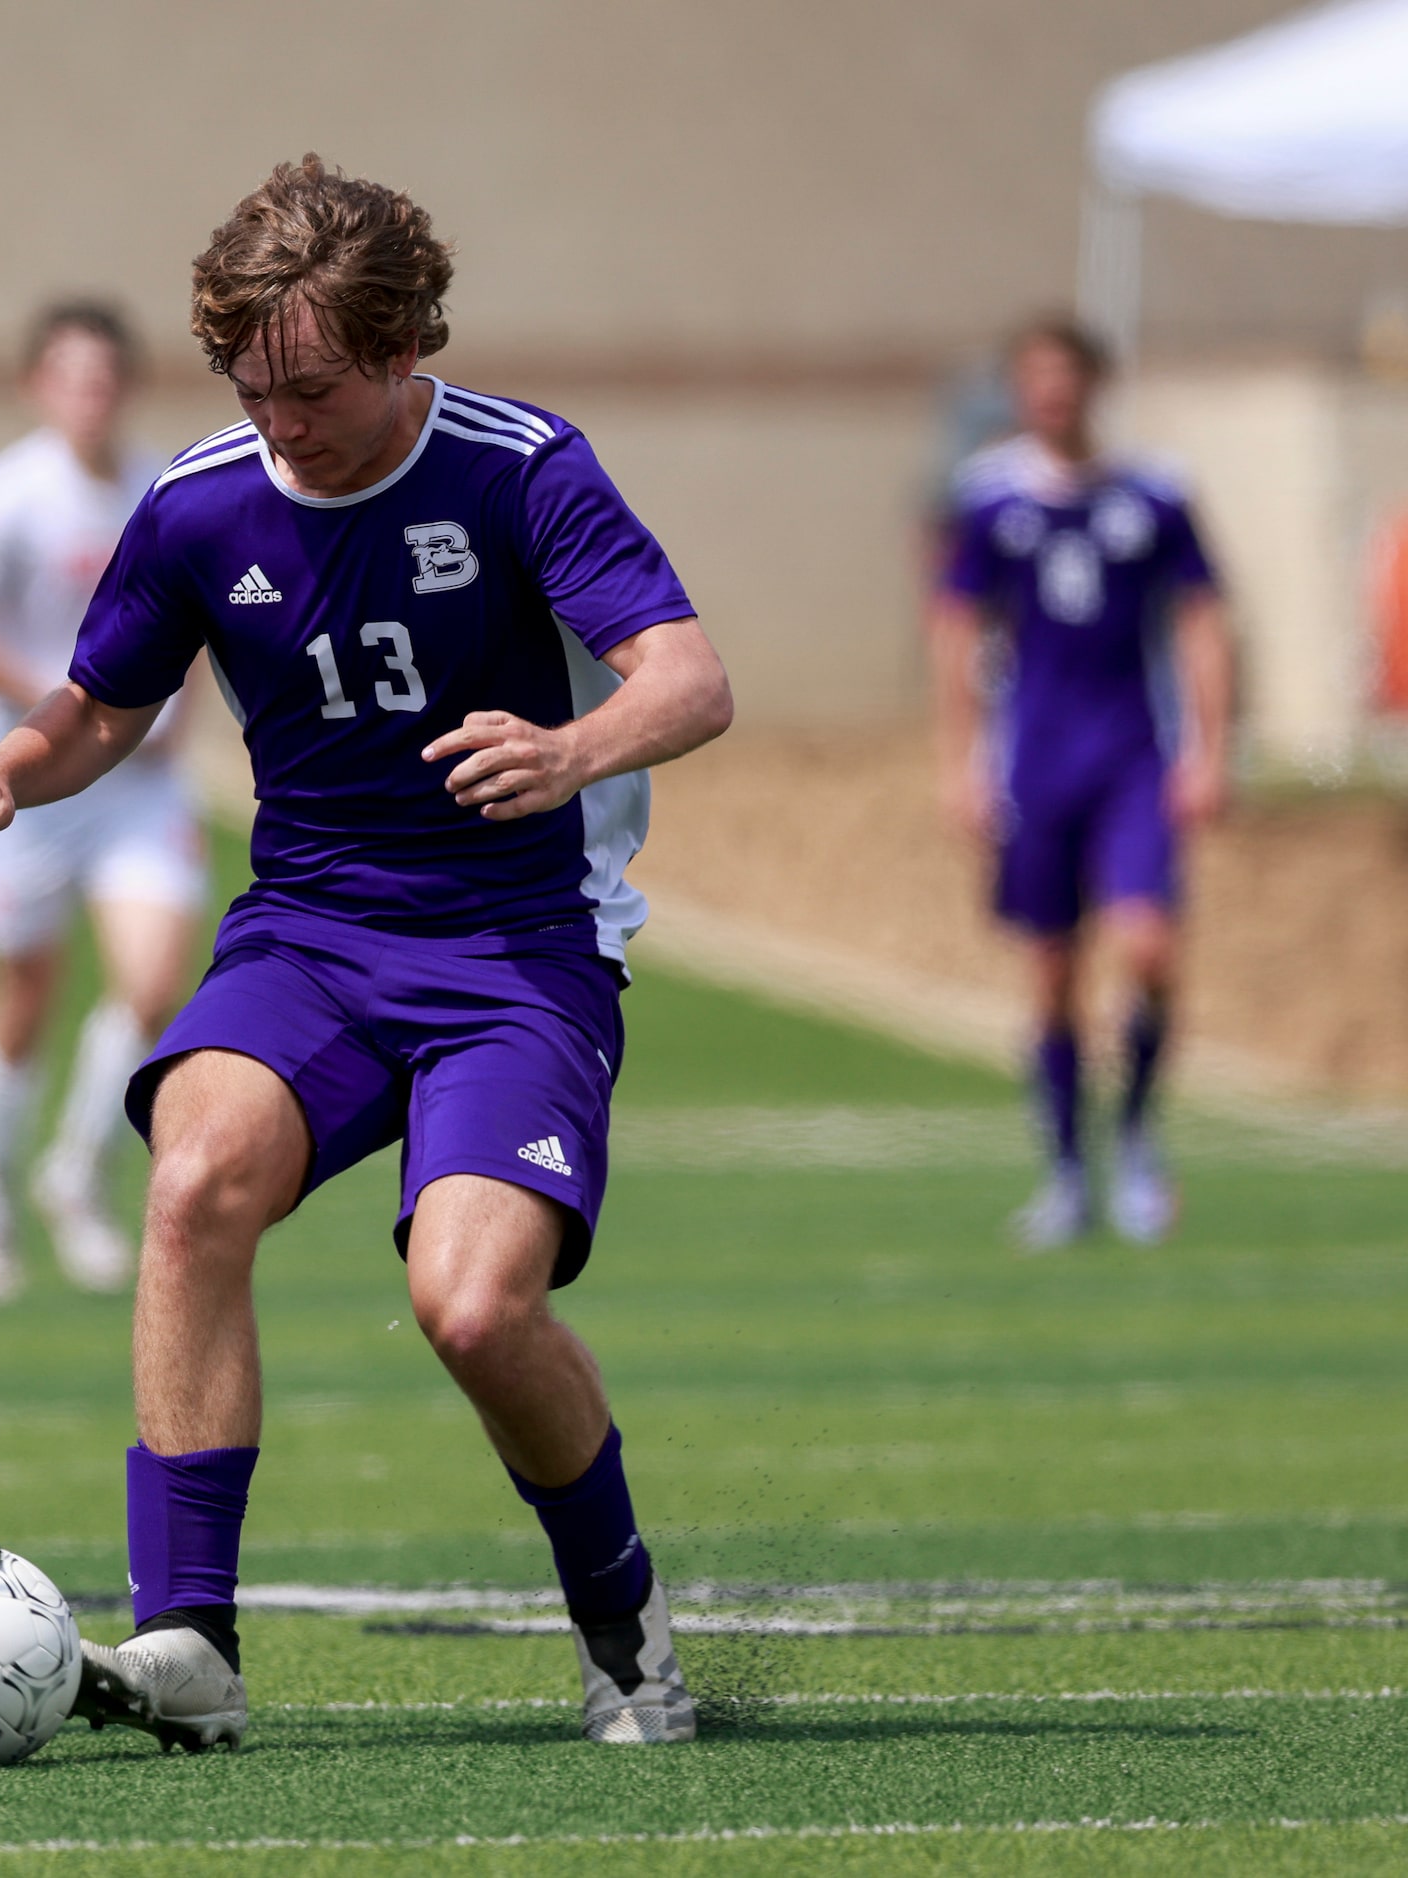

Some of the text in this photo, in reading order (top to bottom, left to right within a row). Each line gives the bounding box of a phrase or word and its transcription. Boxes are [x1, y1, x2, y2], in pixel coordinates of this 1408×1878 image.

[228, 587, 283, 605] adidas
[305, 621, 427, 719] 13
[517, 1146, 572, 1177] adidas
